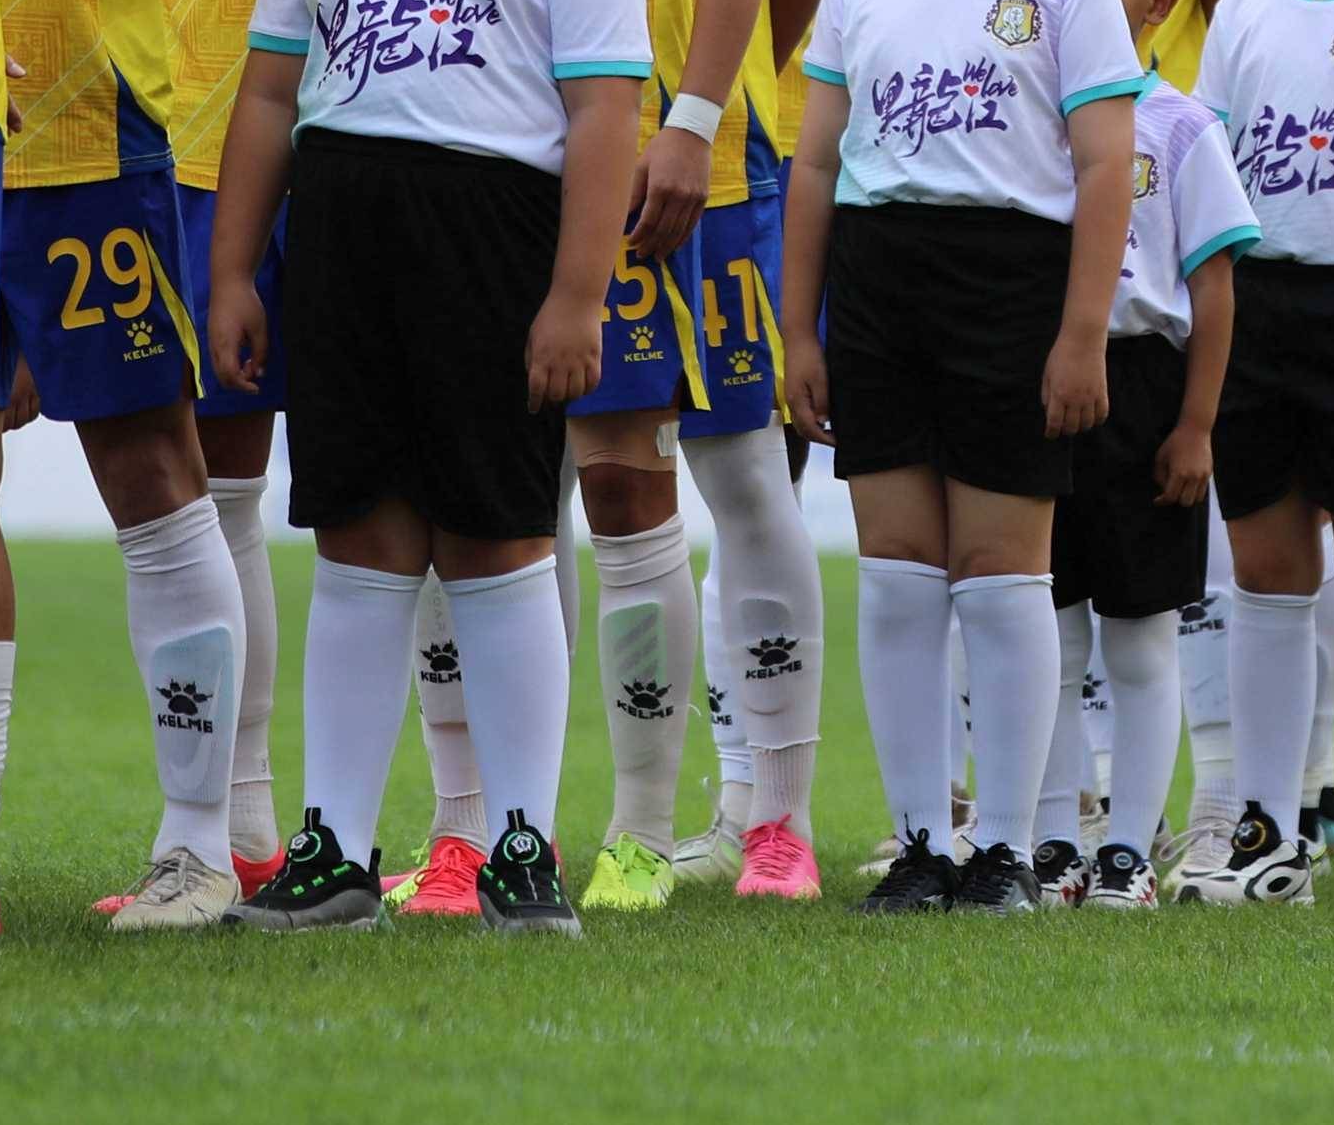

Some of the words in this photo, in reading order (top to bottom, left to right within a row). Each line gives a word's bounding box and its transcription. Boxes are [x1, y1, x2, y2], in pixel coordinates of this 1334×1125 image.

[963, 56, 987, 82] We
[981, 63, 1019, 98] love
[47, 227, 152, 330] 29
[602, 235, 657, 321] 5
[123, 344, 165, 362] KELME
[624, 350, 665, 363] KELME
[723, 372, 763, 387] KELME
[421, 671, 462, 684] KELM
[745, 659, 803, 680] KELME
[617, 699, 674, 720] KELME
[1083, 701, 1108, 711] LME
[157, 714, 214, 734] KELME
[711, 714, 733, 726] LME
